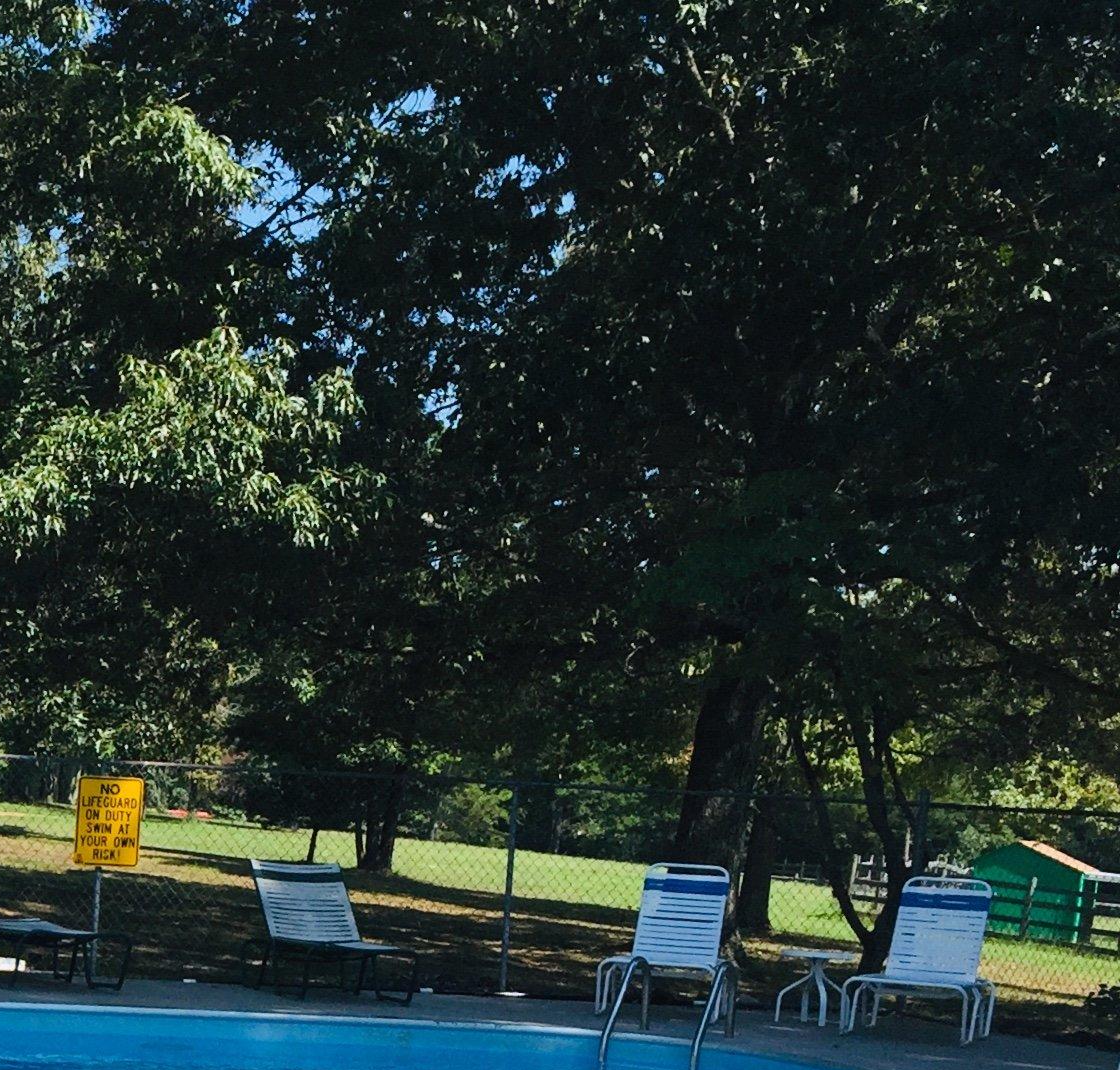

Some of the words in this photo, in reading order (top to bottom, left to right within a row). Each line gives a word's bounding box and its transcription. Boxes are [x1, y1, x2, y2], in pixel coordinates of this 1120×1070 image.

[100, 784, 120, 795] NO
[82, 796, 137, 809] LIFEGUARD
[85, 809, 100, 820] ON
[105, 810, 132, 822] DUTY
[86, 822, 112, 834] SWIM
[118, 824, 130, 835] AT
[80, 835, 107, 847] YOUR
[113, 837, 136, 848] OWN
[92, 848, 120, 861] RISK!
